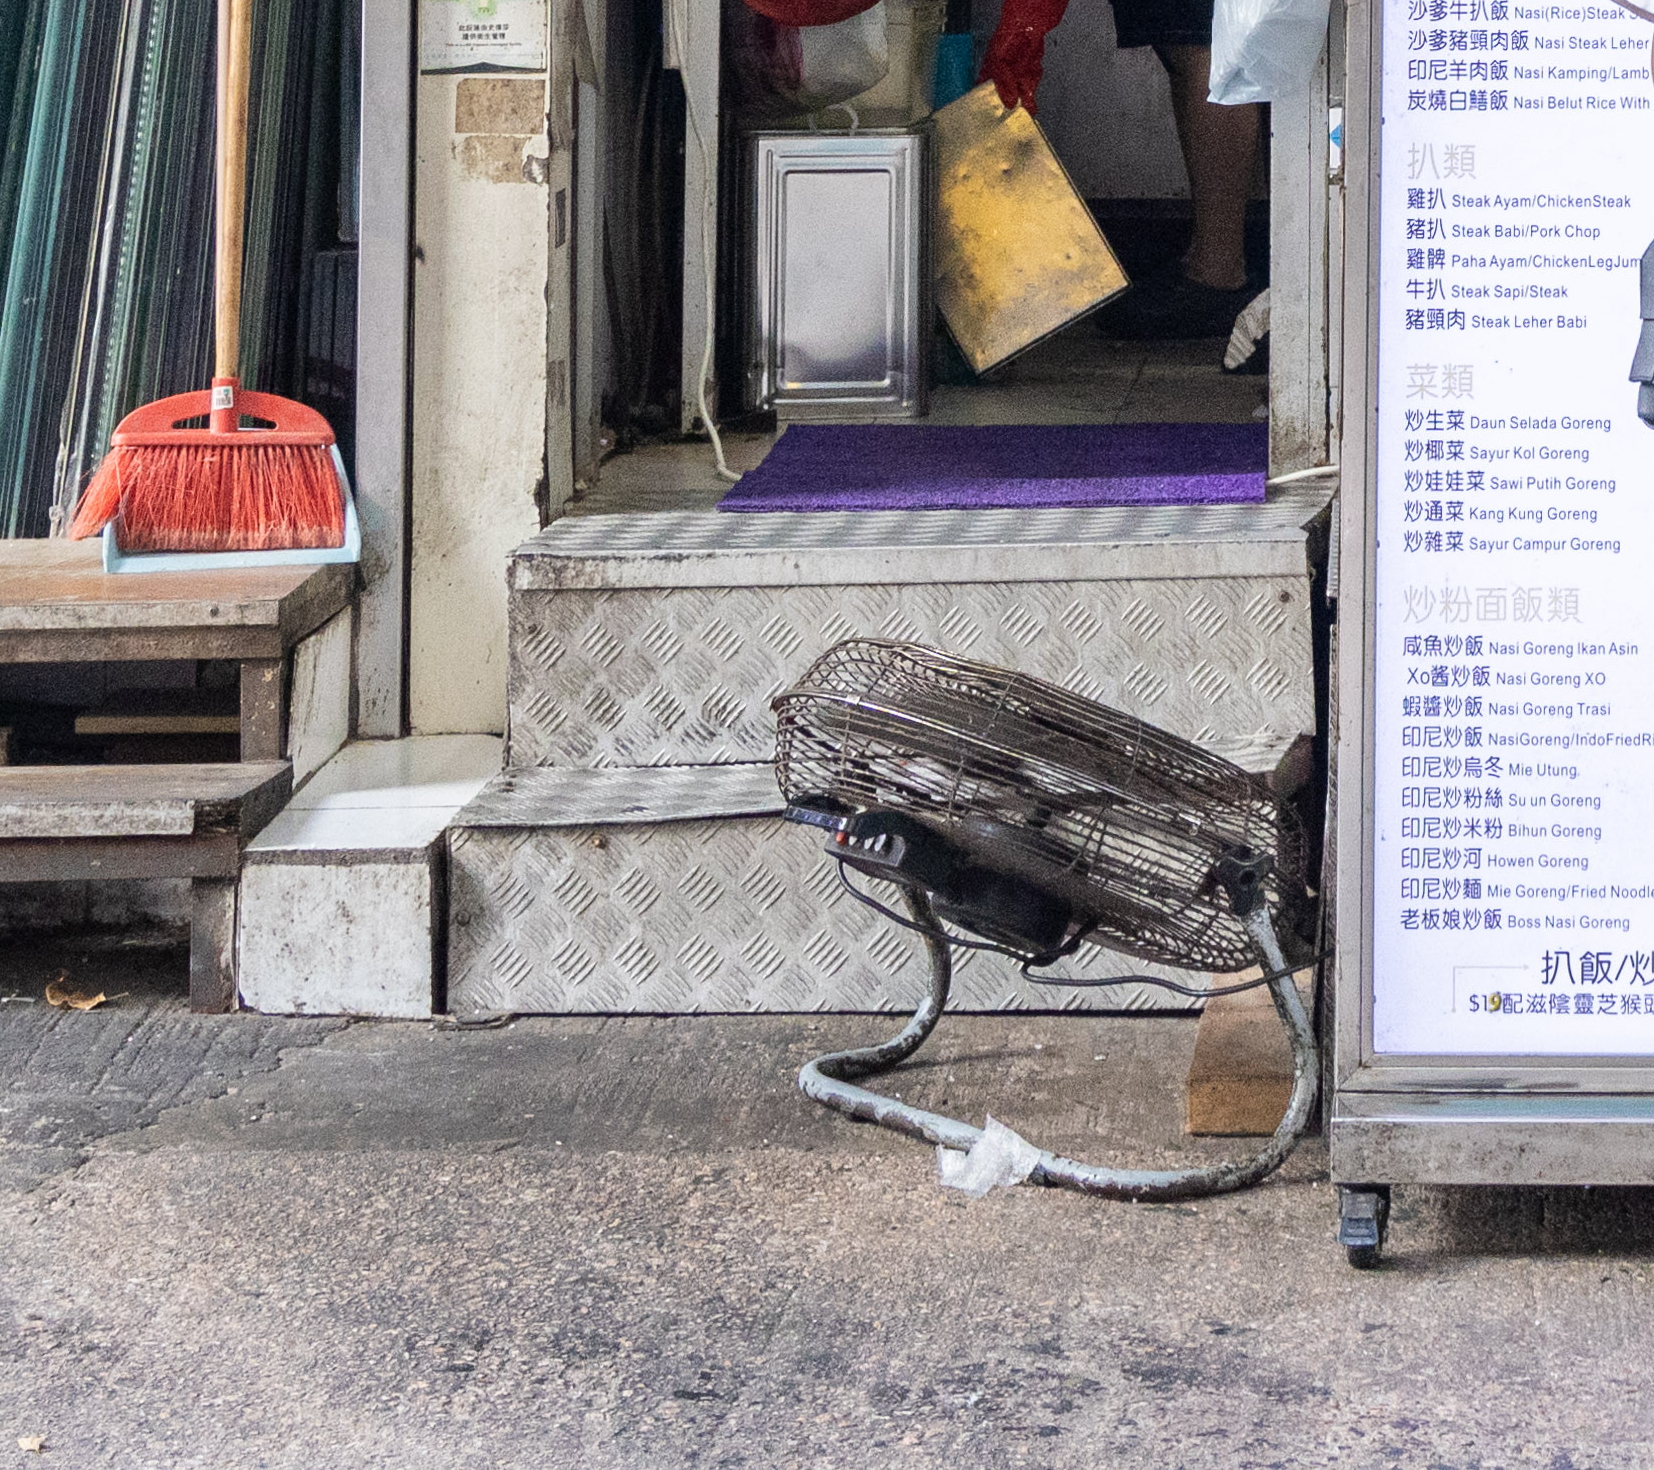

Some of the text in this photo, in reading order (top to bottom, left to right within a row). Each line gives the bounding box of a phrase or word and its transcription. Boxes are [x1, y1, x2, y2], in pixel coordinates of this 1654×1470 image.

[1408, 143, 1476, 179] 扒類
[1407, 188, 1631, 210] 雞扒 Steak Ayam/ChickenSteak
[1406, 279, 1568, 301] 牛扒 Steak Sapi/Steak
[1405, 409, 1611, 432] 炒生菜 Daun Selada Goreng
[1403, 586, 1582, 623] 炒粉面飯類
[1403, 635, 1484, 657] 咸魚炒飯
[1401, 847, 1482, 870] 印尼炒河
[1488, 855, 1533, 868] Howen
[1538, 855, 1588, 871] Goreng
[1401, 909, 1502, 931] 老板娘炒飯
